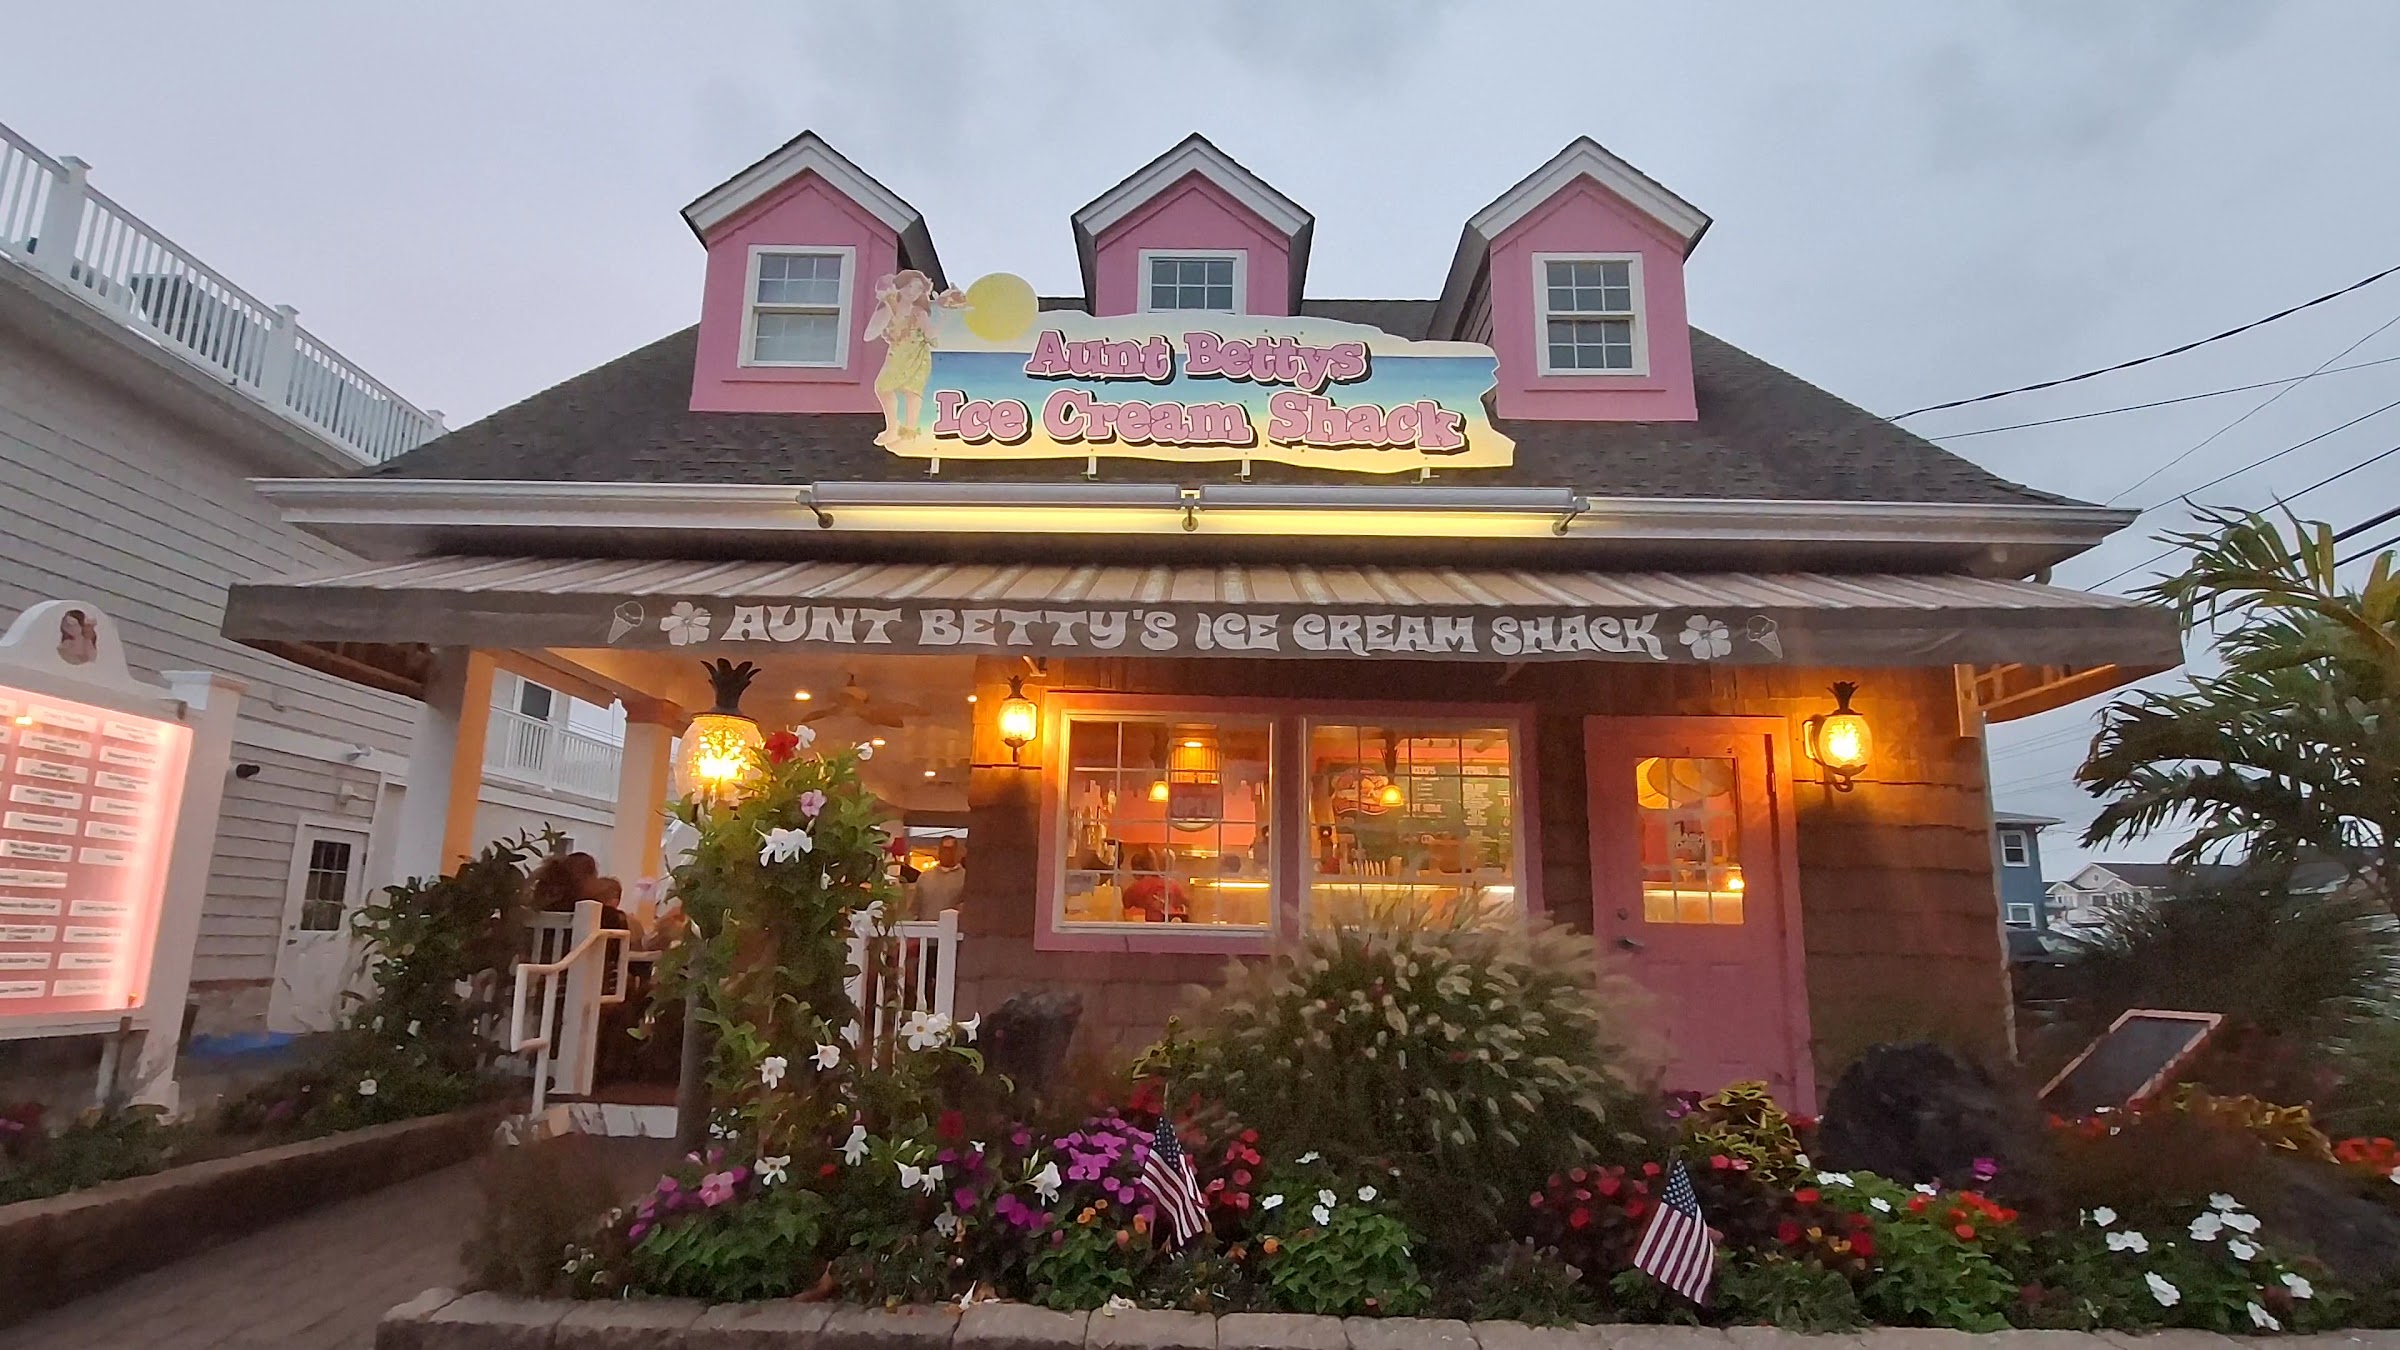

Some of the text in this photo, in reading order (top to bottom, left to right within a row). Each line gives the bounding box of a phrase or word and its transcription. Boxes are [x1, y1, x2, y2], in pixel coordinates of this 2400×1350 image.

[1024, 330, 1368, 390] Aunt Bettys
[933, 388, 1465, 449] Ice Cream Shack
[720, 604, 1669, 661] AUNT BETTY'S ICE CREAM SHACK
